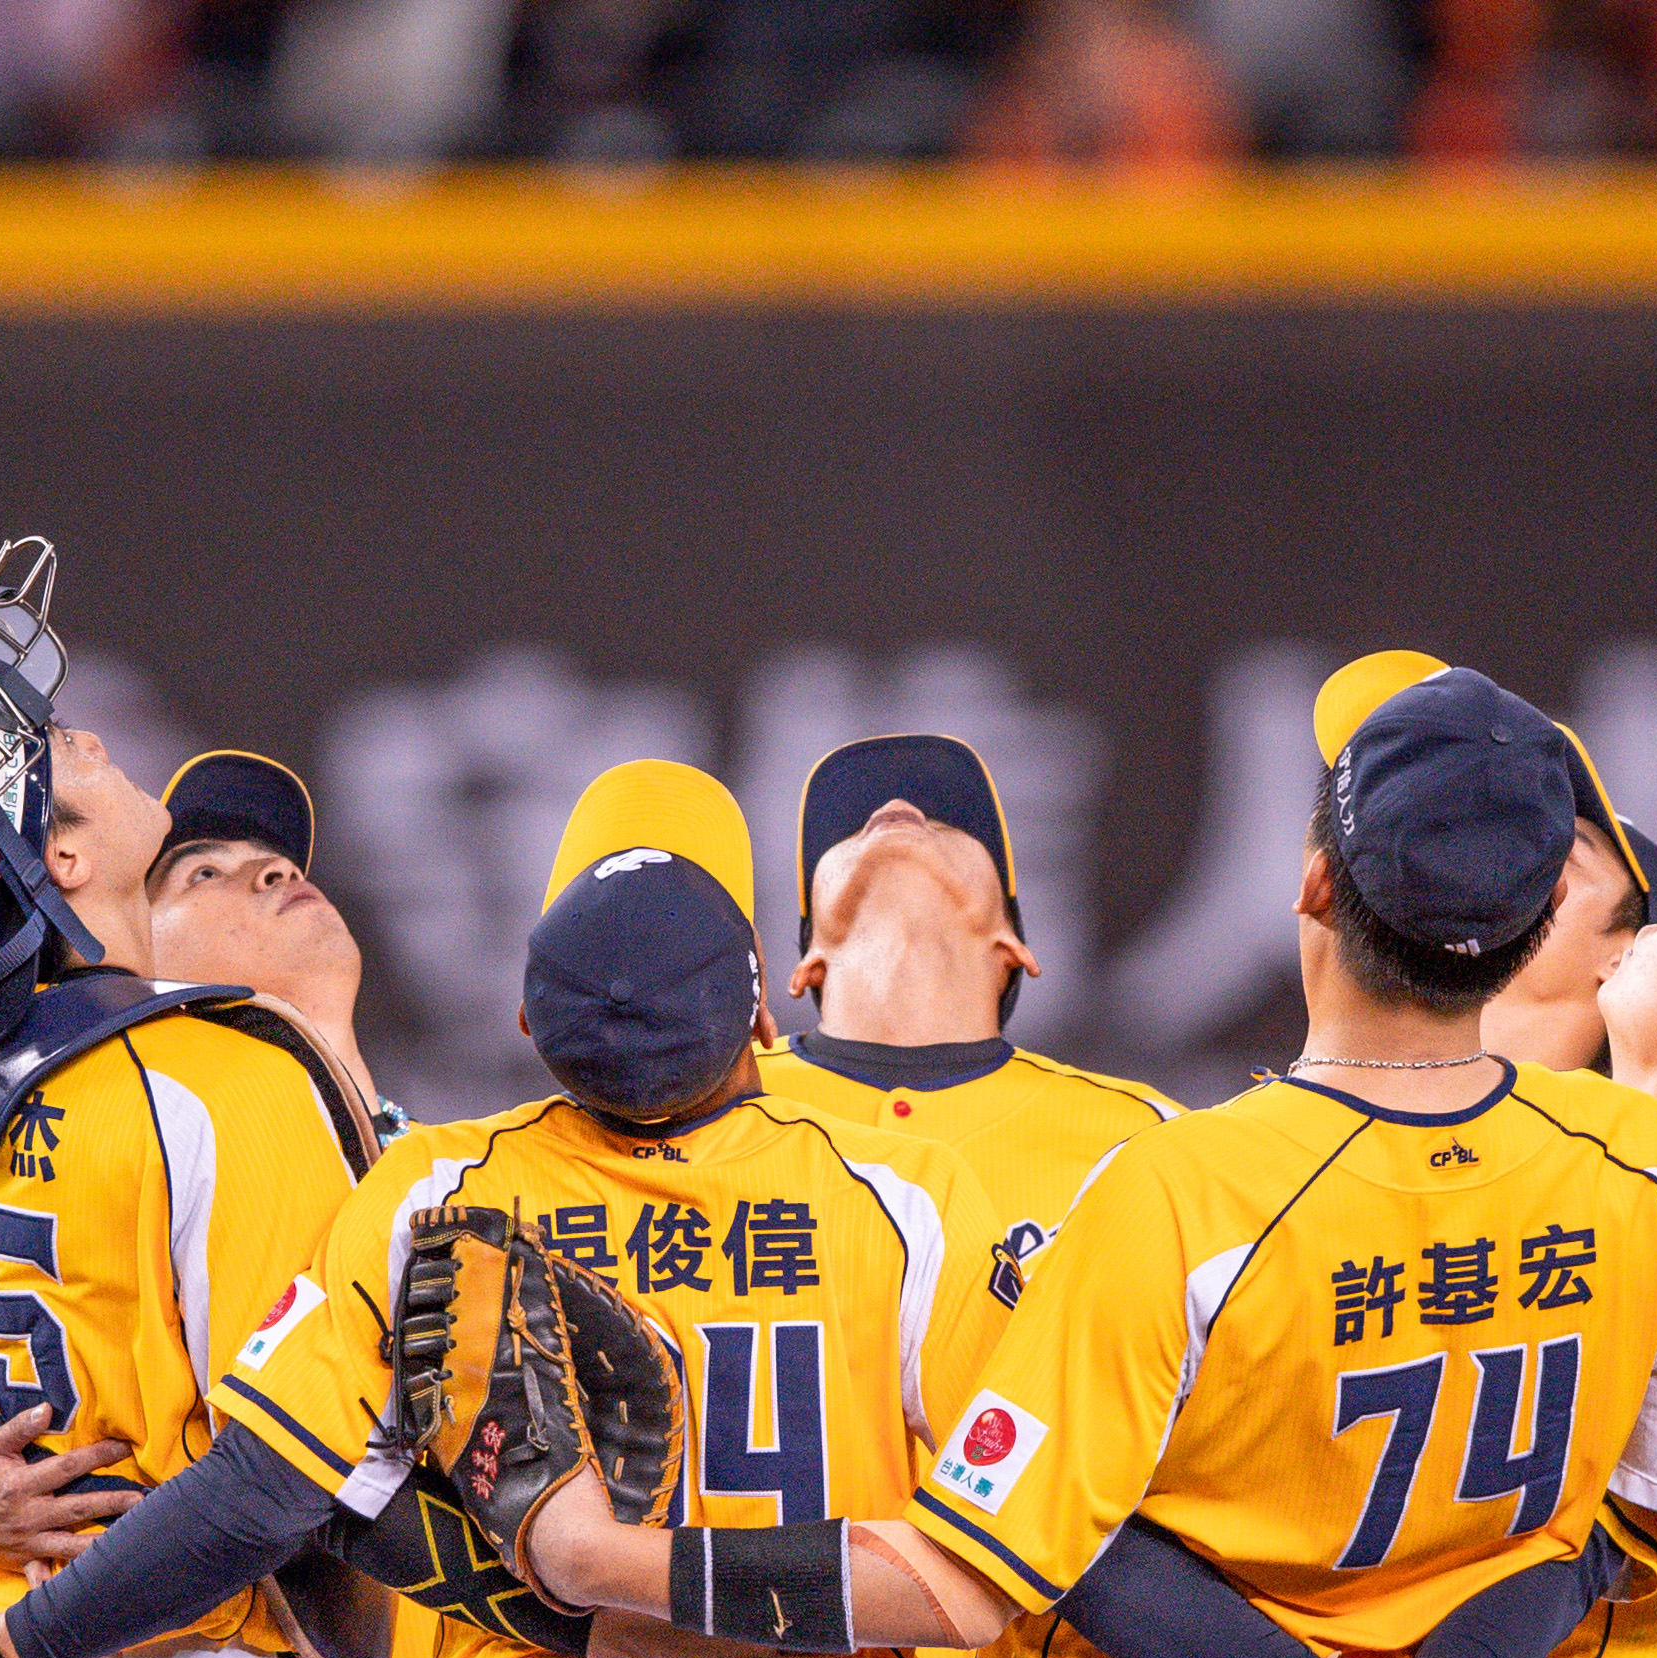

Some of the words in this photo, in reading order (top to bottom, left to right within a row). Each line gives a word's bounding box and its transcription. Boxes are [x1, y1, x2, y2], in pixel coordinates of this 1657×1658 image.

[1336, 746, 1355, 836] 守信人力
[632, 1146, 689, 1164] CPBL
[1430, 1148, 1479, 1167] CPBL
[539, 1199, 820, 1297] 吳俊偉
[1331, 1224, 1597, 1347] 許基宏
[645, 1318, 831, 1526] 4
[1331, 1332, 1583, 1571] 74
[939, 1457, 995, 1498] 台灣人壽
